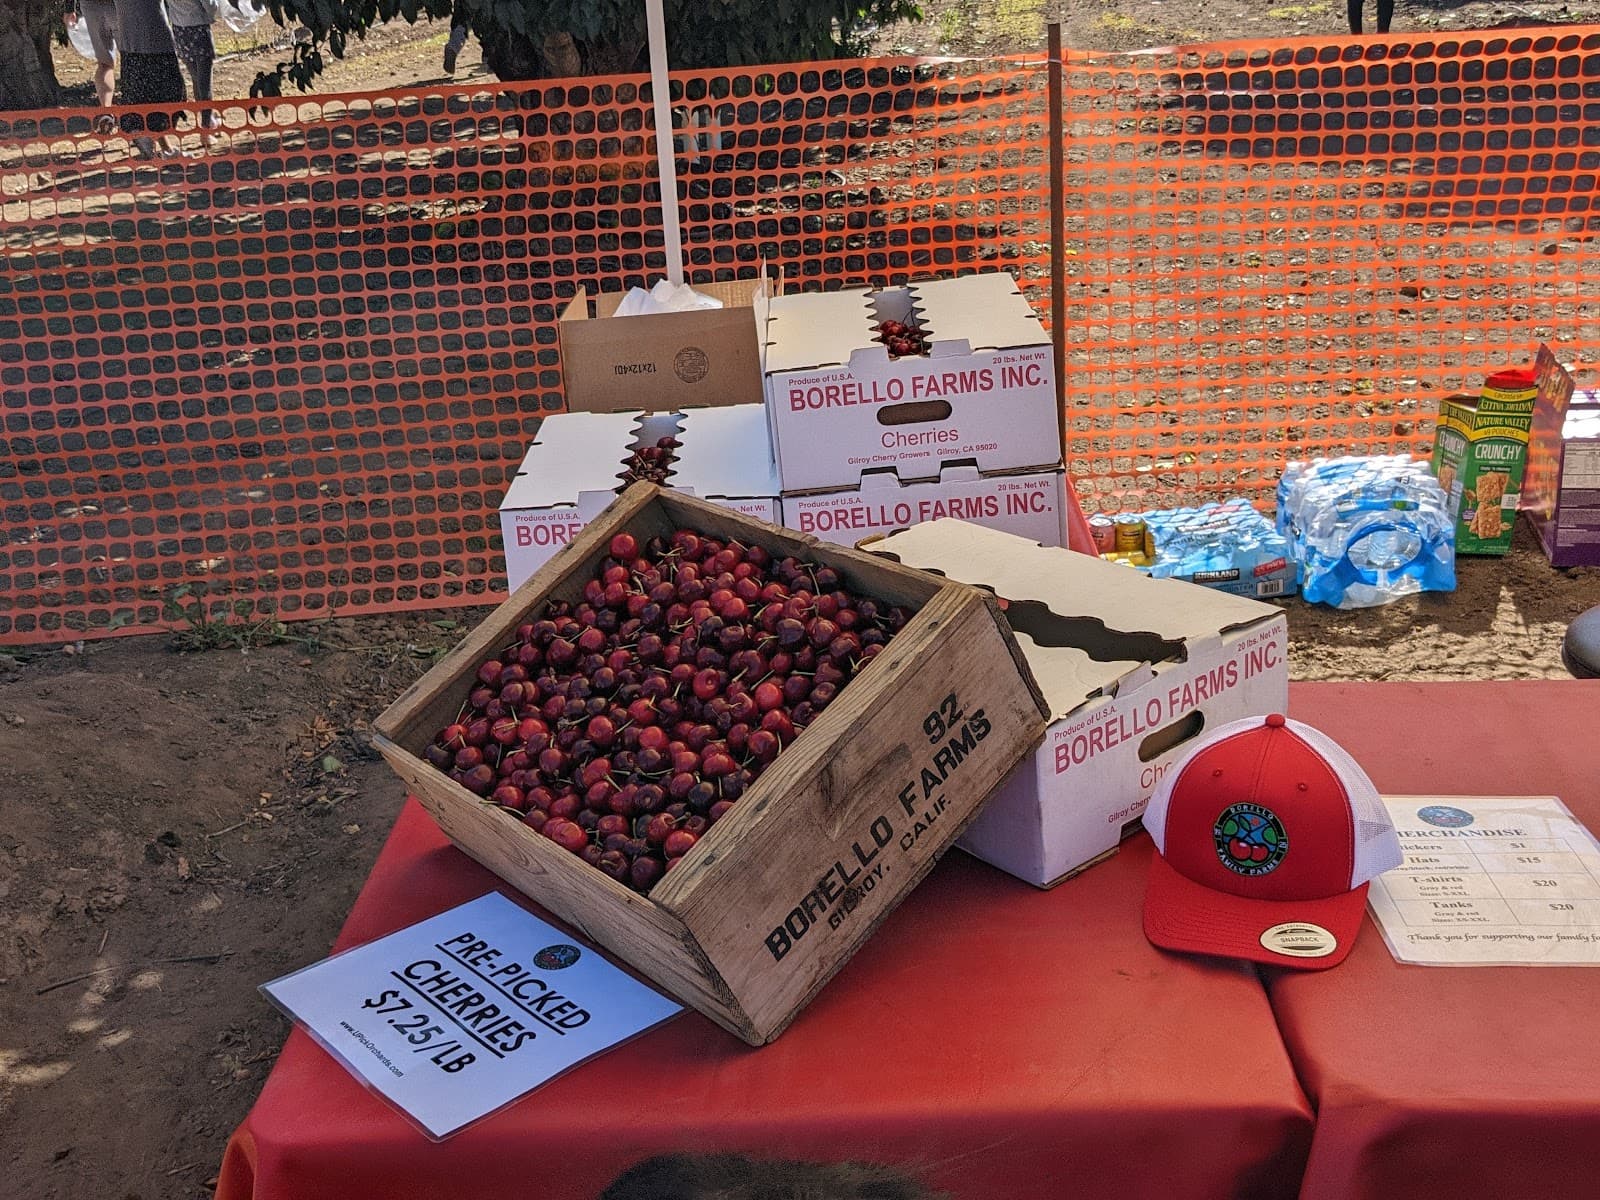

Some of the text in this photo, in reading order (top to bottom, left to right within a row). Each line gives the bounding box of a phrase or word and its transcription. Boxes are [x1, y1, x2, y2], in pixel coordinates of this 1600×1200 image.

[788, 372, 855, 387] Produce of U.S.A.
[789, 363, 1048, 412] BORELLO FARMS INC.
[1475, 416, 1530, 431] NATURE VALLEY
[881, 427, 959, 448] Cherries
[848, 456, 870, 465] Gilroy
[872, 454, 897, 462] Cherry
[899, 452, 931, 460] Growers
[962, 445, 974, 453] CA
[975, 443, 998, 451] 95020
[1475, 443, 1522, 460] CRUNCHY
[1024, 481, 1038, 489] Net
[799, 501, 829, 509] Produce
[840, 497, 864, 505] U.S.A.
[799, 491, 1053, 532] BORELLO FARMS INC.
[515, 514, 547, 522] Produce
[557, 512, 581, 520] U.S.A.
[516, 523, 588, 547] BORE
[1194, 569, 1239, 580] KIRKLAND
[1238, 642, 1246, 651] 20
[1260, 631, 1271, 640] Net
[923, 692, 964, 745] 92
[1055, 698, 1163, 775] BORELLO
[1168, 660, 1238, 717] FARMS
[1244, 641, 1283, 680] INC.
[1054, 722, 1085, 740] Produce
[1087, 714, 1094, 725] of
[1108, 795, 1152, 823] Gilroy Cherr
[1230, 805, 1275, 820] BORELLO
[900, 794, 952, 851] CALIF.
[764, 708, 992, 961] BORELLO FARMS
[1217, 848, 1246, 874] FAMILY
[1249, 858, 1279, 876] FARMS
[1409, 856, 1542, 864] Hats $15
[1533, 879, 1558, 887] $20
[1429, 901, 1575, 911] Tanks $20
[1407, 933, 1442, 944] Thank
[1443, 935, 1463, 943] you
[1464, 933, 1479, 942] for
[1482, 933, 1536, 942] supporting
[1556, 932, 1590, 943] family
[443, 932, 591, 1030] PRE-PICKED
[404, 959, 537, 1053] CHERRIES
[361, 990, 477, 1073] $7.25/LB
